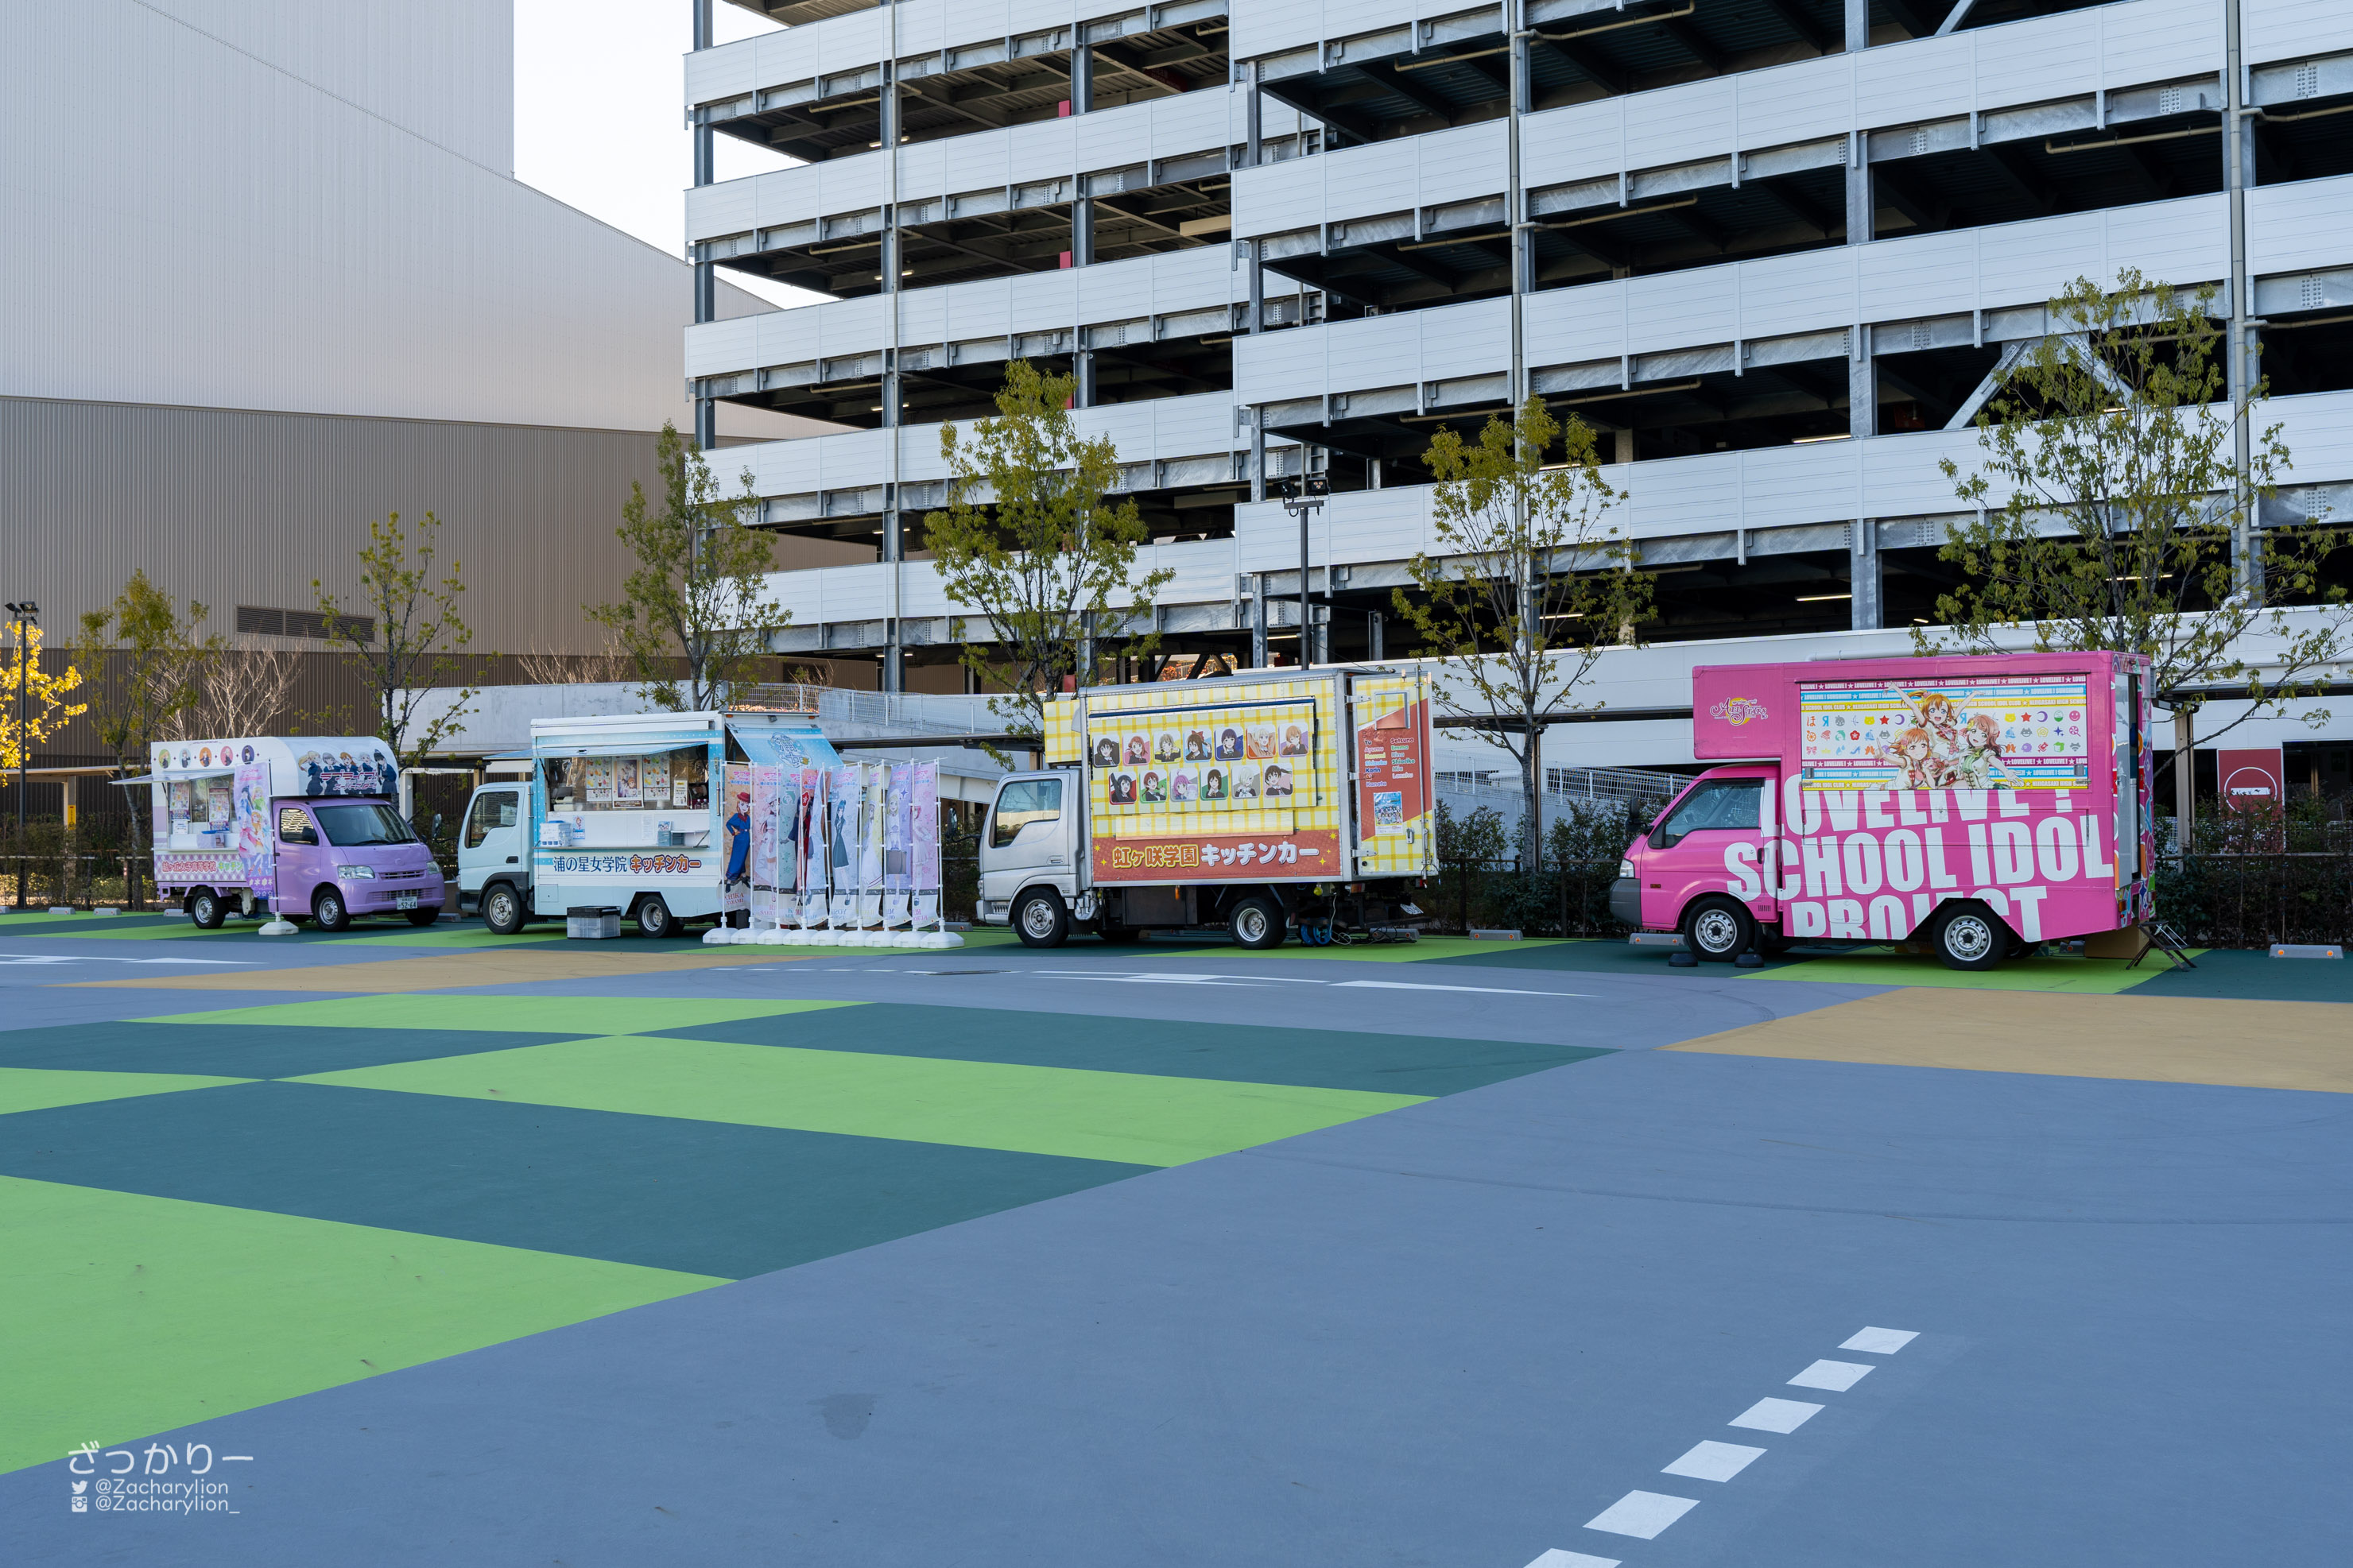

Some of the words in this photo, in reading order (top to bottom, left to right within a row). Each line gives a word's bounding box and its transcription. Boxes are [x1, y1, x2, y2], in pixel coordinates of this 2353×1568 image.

[552, 856, 628, 873] 浦の星女学院
[630, 854, 702, 873] キッチンカー
[1201, 841, 1320, 867] キッチンカー
[1723, 827, 1957, 902] SCHOOL
[1967, 815, 2115, 886] IDOL
